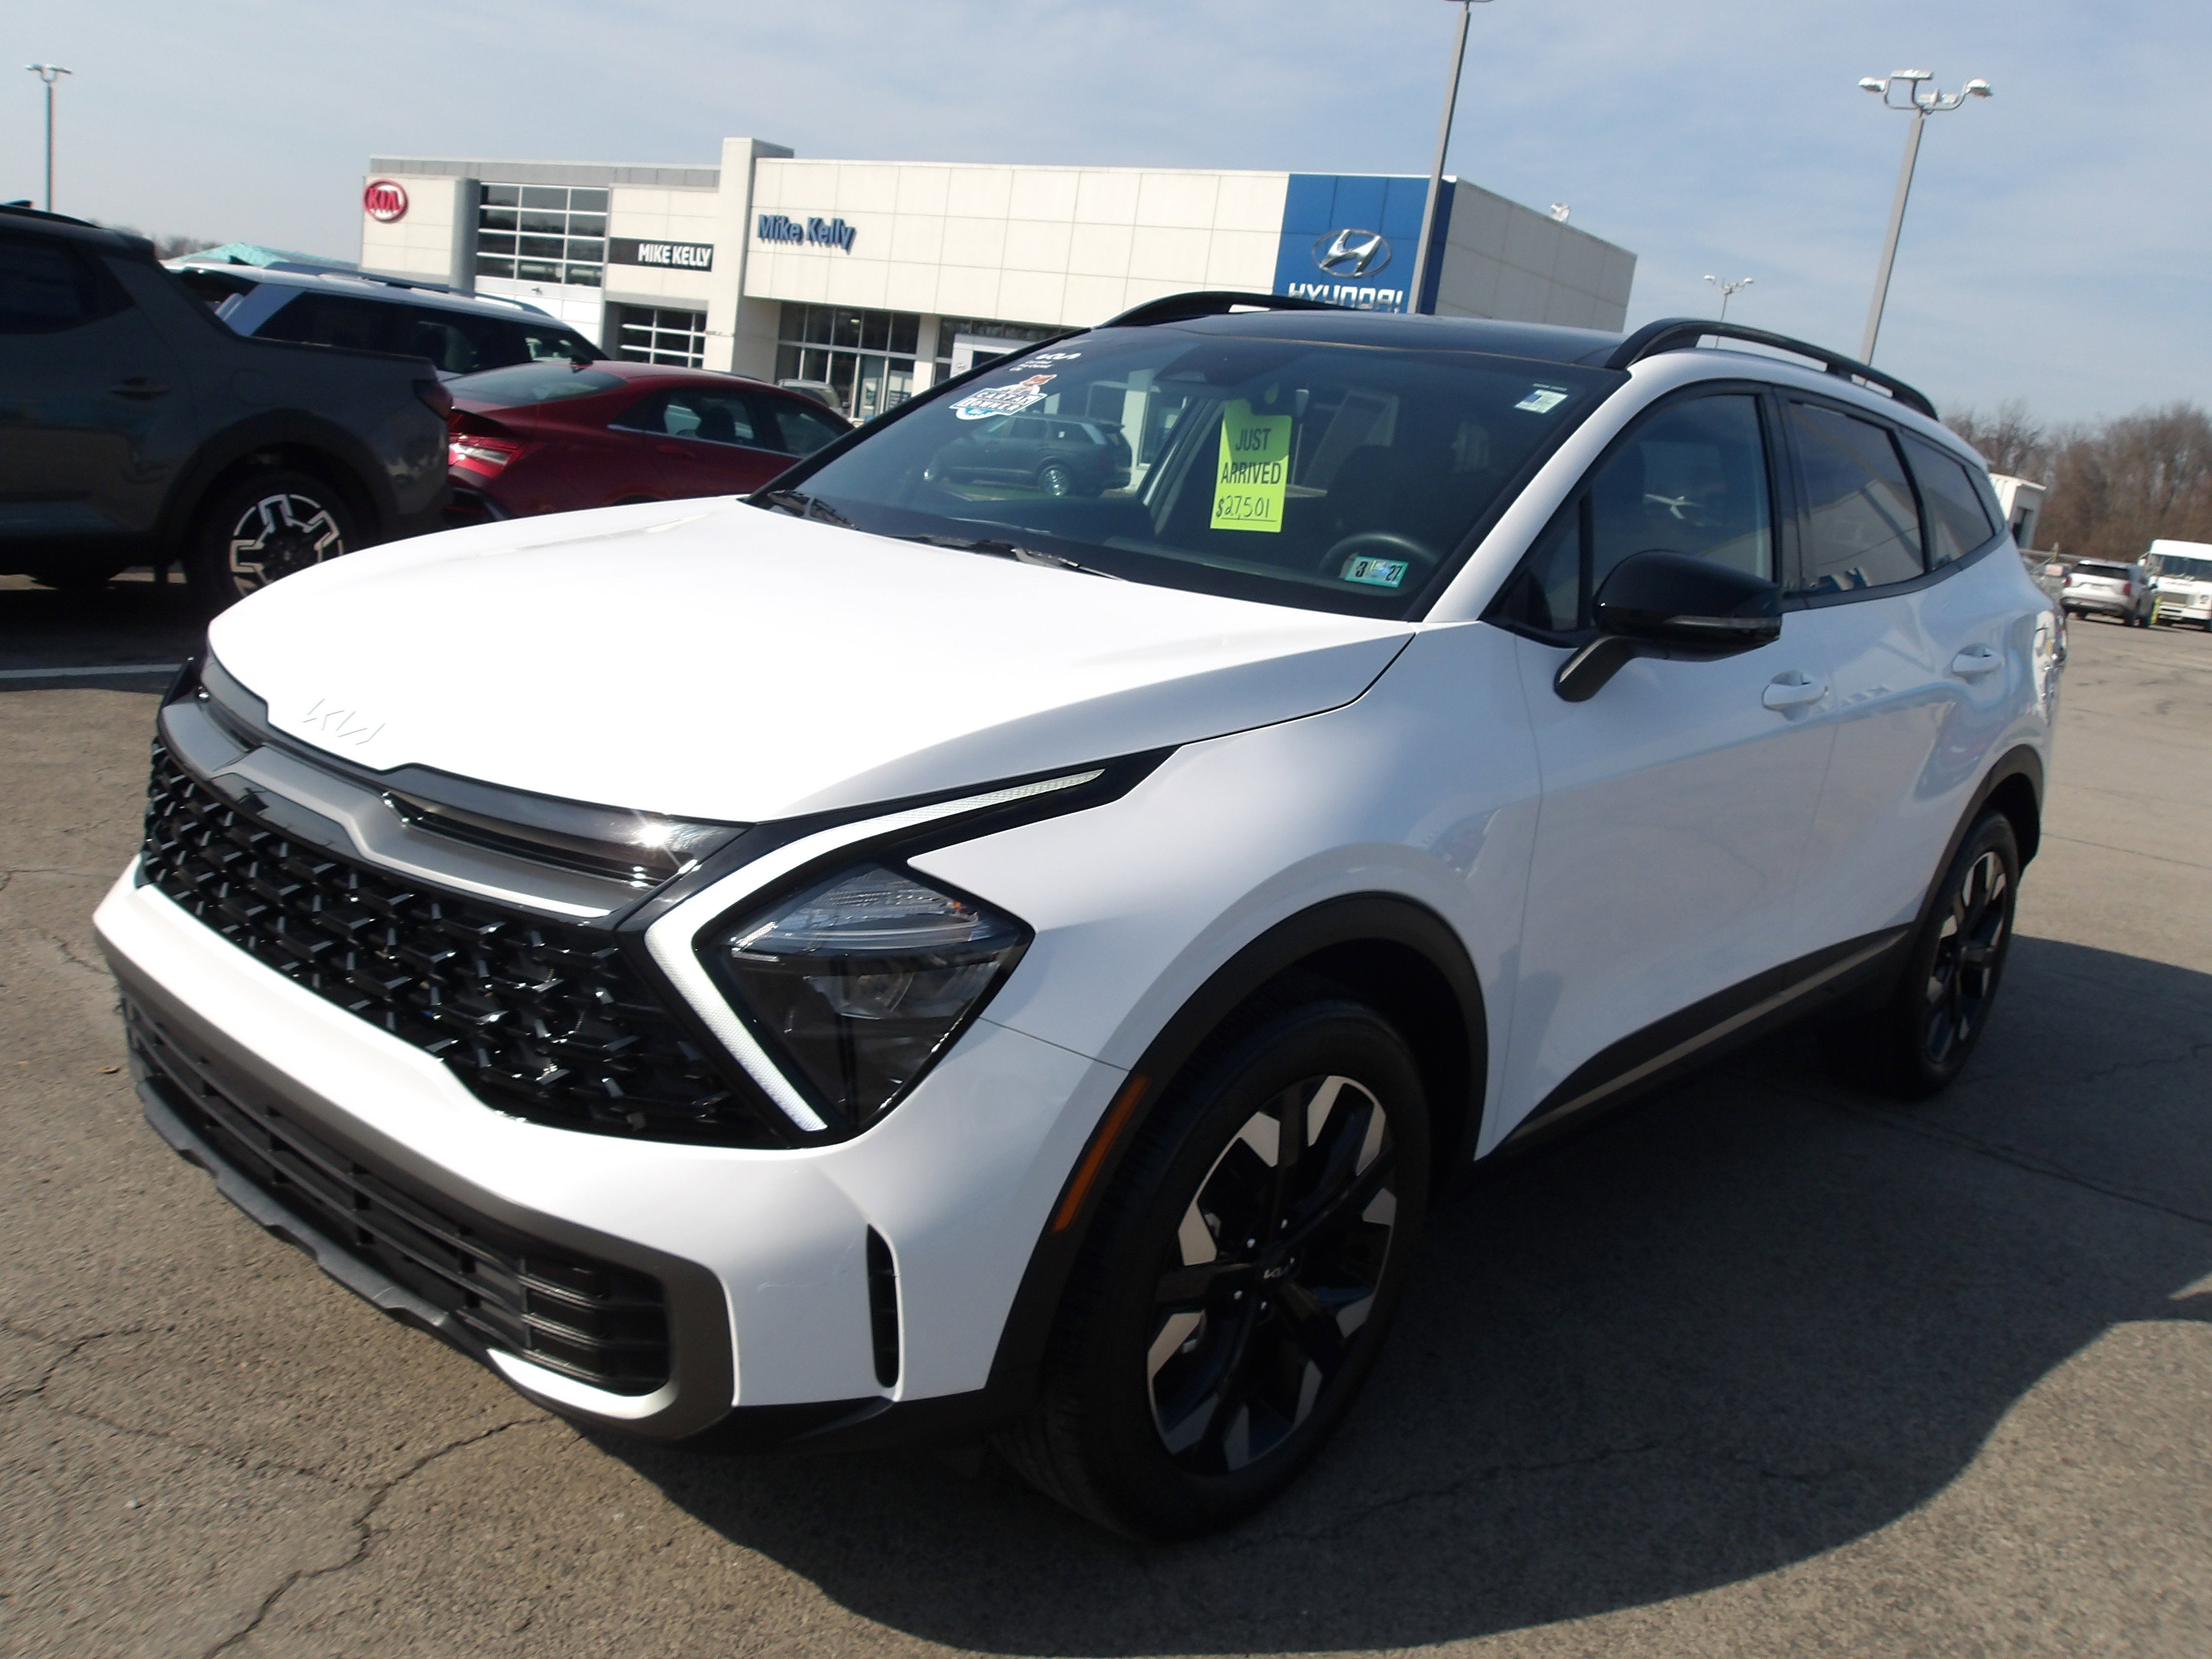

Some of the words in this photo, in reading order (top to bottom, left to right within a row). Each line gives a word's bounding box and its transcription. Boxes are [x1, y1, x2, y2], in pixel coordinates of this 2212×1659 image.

[367, 187, 402, 212] KIA
[757, 214, 804, 243] Mike
[806, 216, 856, 252] Kelly
[638, 243, 672, 264] MIKE
[672, 245, 712, 267] KELLY
[1288, 282, 1403, 313] HYUNDAI
[1235, 428, 1271, 451] JUST
[1221, 462, 1281, 484] ARRIVED
[1216, 495, 1270, 520] $27,501
[1355, 561, 1368, 577] 3
[1385, 565, 1404, 581] 27
